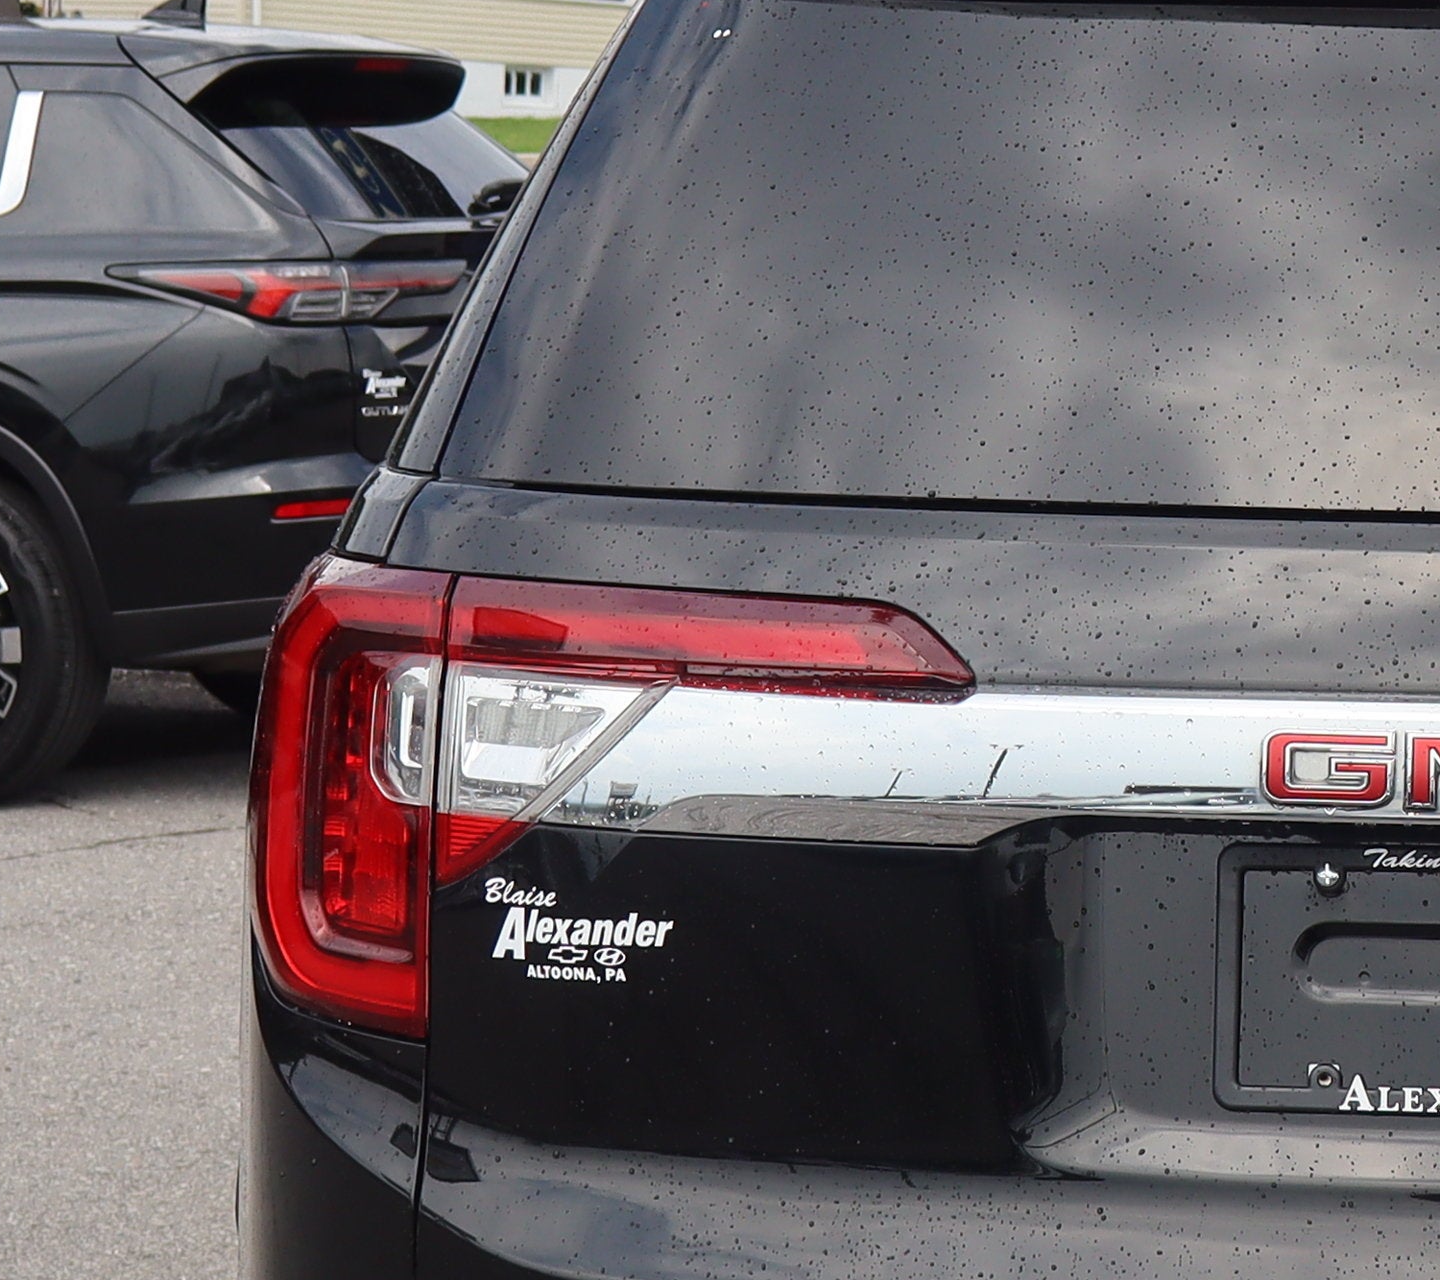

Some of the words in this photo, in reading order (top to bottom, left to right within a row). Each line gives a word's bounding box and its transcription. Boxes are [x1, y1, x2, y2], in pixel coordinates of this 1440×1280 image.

[485, 877, 557, 907] Blaise
[492, 906, 674, 960] Alexander
[526, 965, 601, 984] ALTOONA,
[605, 968, 627, 982] PA
